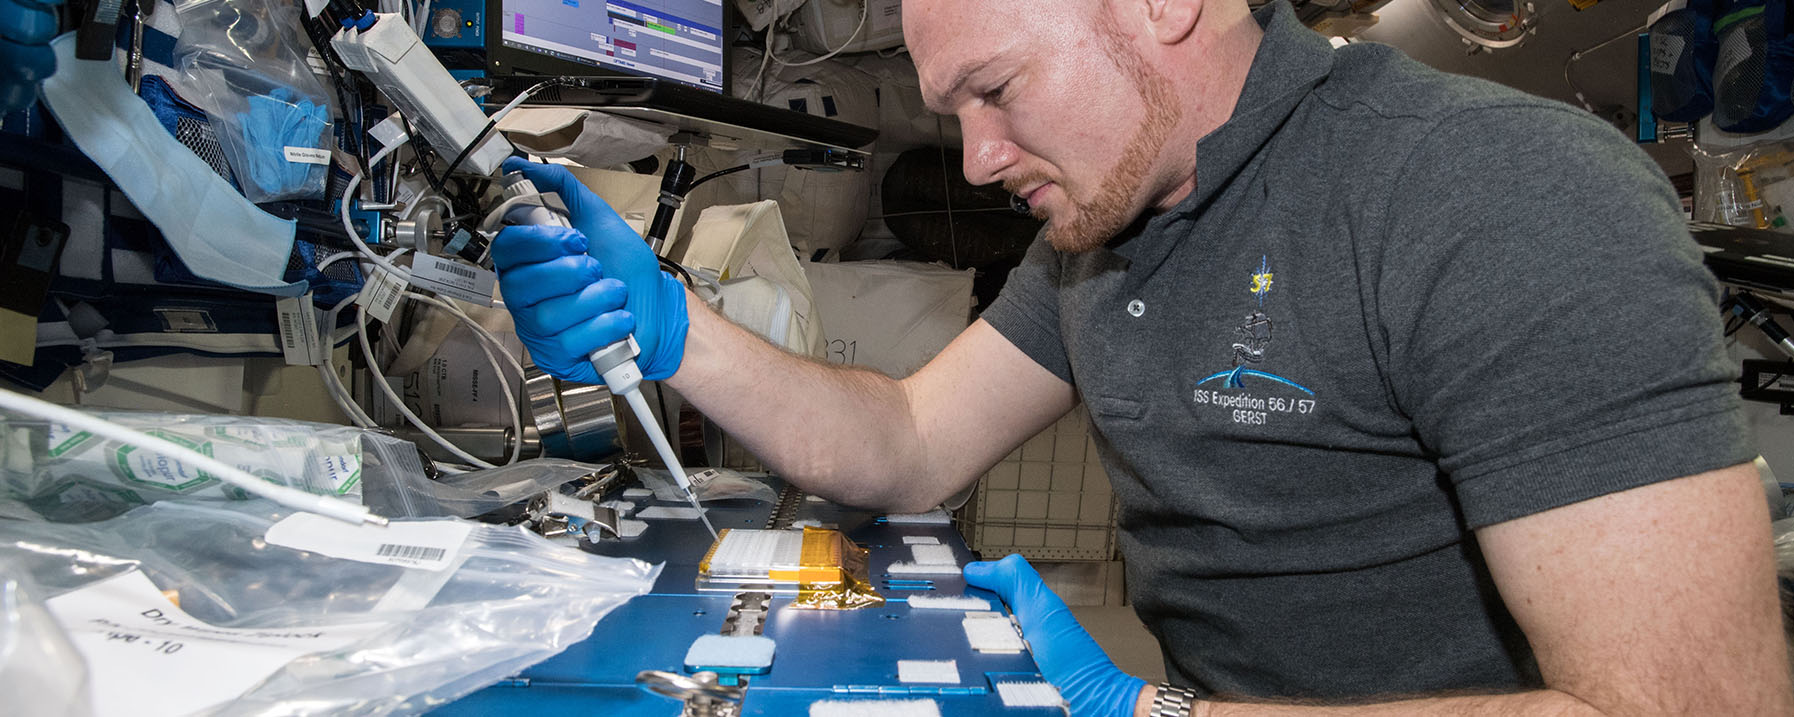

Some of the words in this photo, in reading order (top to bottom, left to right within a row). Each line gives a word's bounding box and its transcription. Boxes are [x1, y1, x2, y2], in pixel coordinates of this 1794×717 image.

[1250, 273, 1273, 293] 57
[622, 372, 632, 381] 10
[1193, 389, 1210, 404] ISS
[1212, 391, 1265, 410] Expedition
[1232, 409, 1267, 425] GERST
[141, 608, 174, 625] Dry
[154, 640, 184, 655] 10
